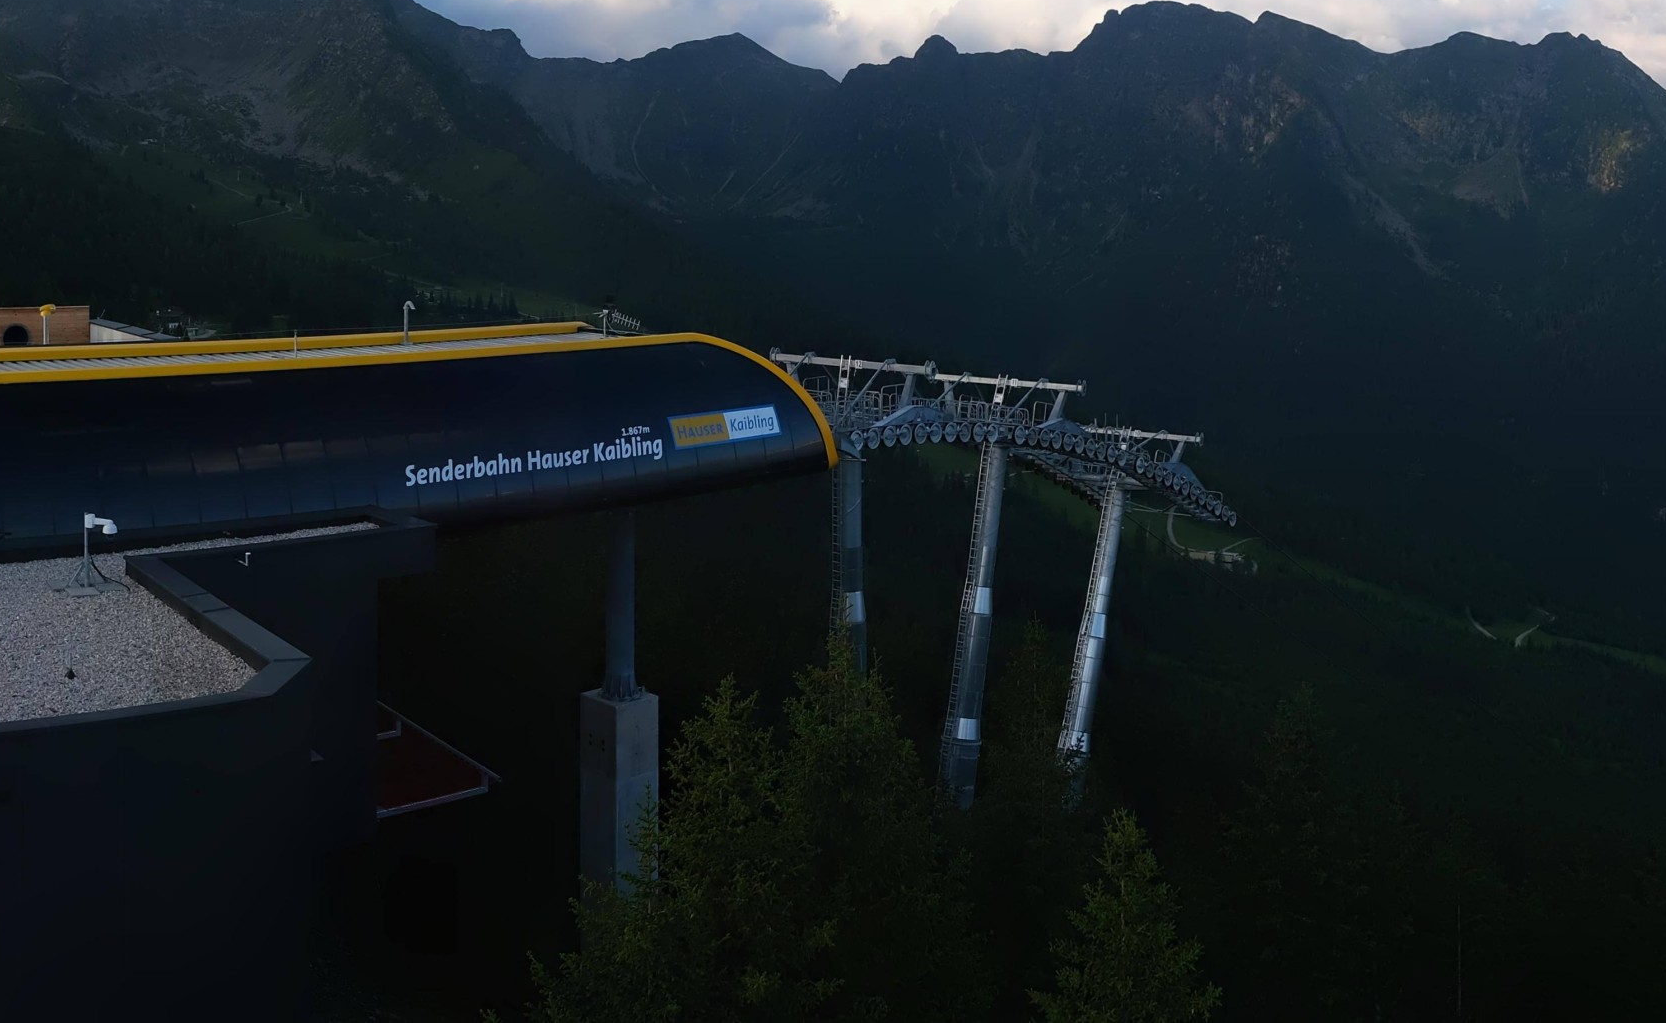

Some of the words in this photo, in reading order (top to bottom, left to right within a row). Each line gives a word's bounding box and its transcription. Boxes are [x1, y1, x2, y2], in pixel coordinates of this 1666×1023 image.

[621, 425, 650, 436] 1.867m
[677, 423, 724, 440] HAUSER
[730, 415, 775, 434] Kaibling
[405, 454, 523, 487] Senderbahn
[527, 447, 590, 471] Hauser
[594, 436, 663, 464] Kaibling
